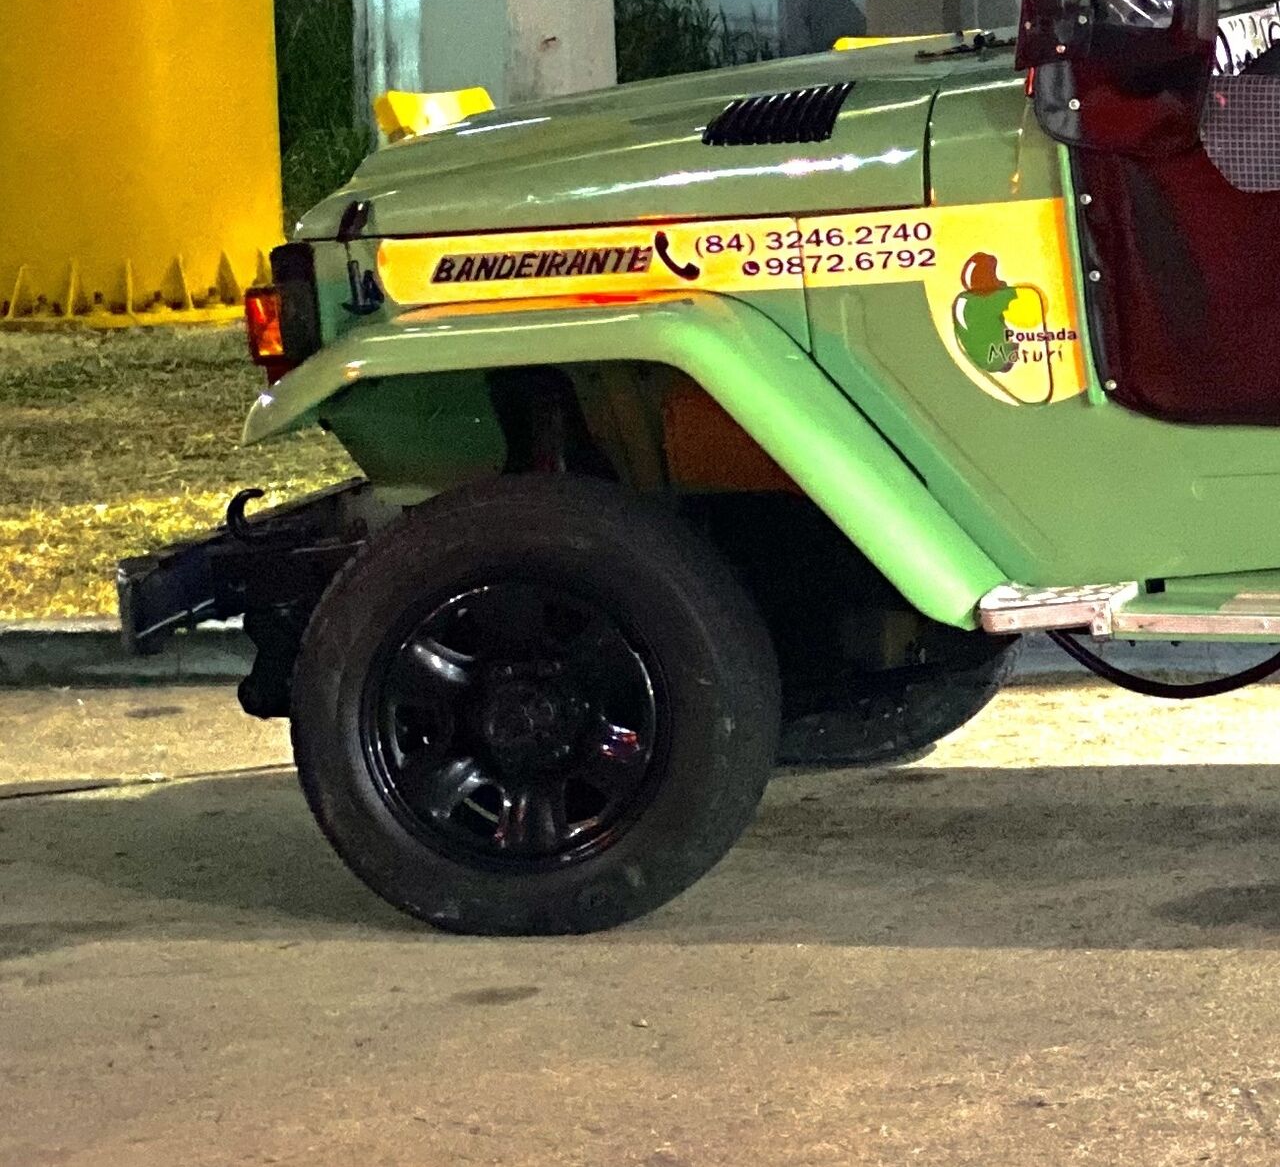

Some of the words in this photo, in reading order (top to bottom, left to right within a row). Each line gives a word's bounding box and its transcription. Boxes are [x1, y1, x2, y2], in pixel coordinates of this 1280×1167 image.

[694, 233, 756, 258] (84)
[765, 222, 932, 250] 3246.2740
[431, 245, 653, 283] BANDEIRANTE
[765, 248, 936, 275] 9872.6792
[1004, 328, 1077, 342] Pousada
